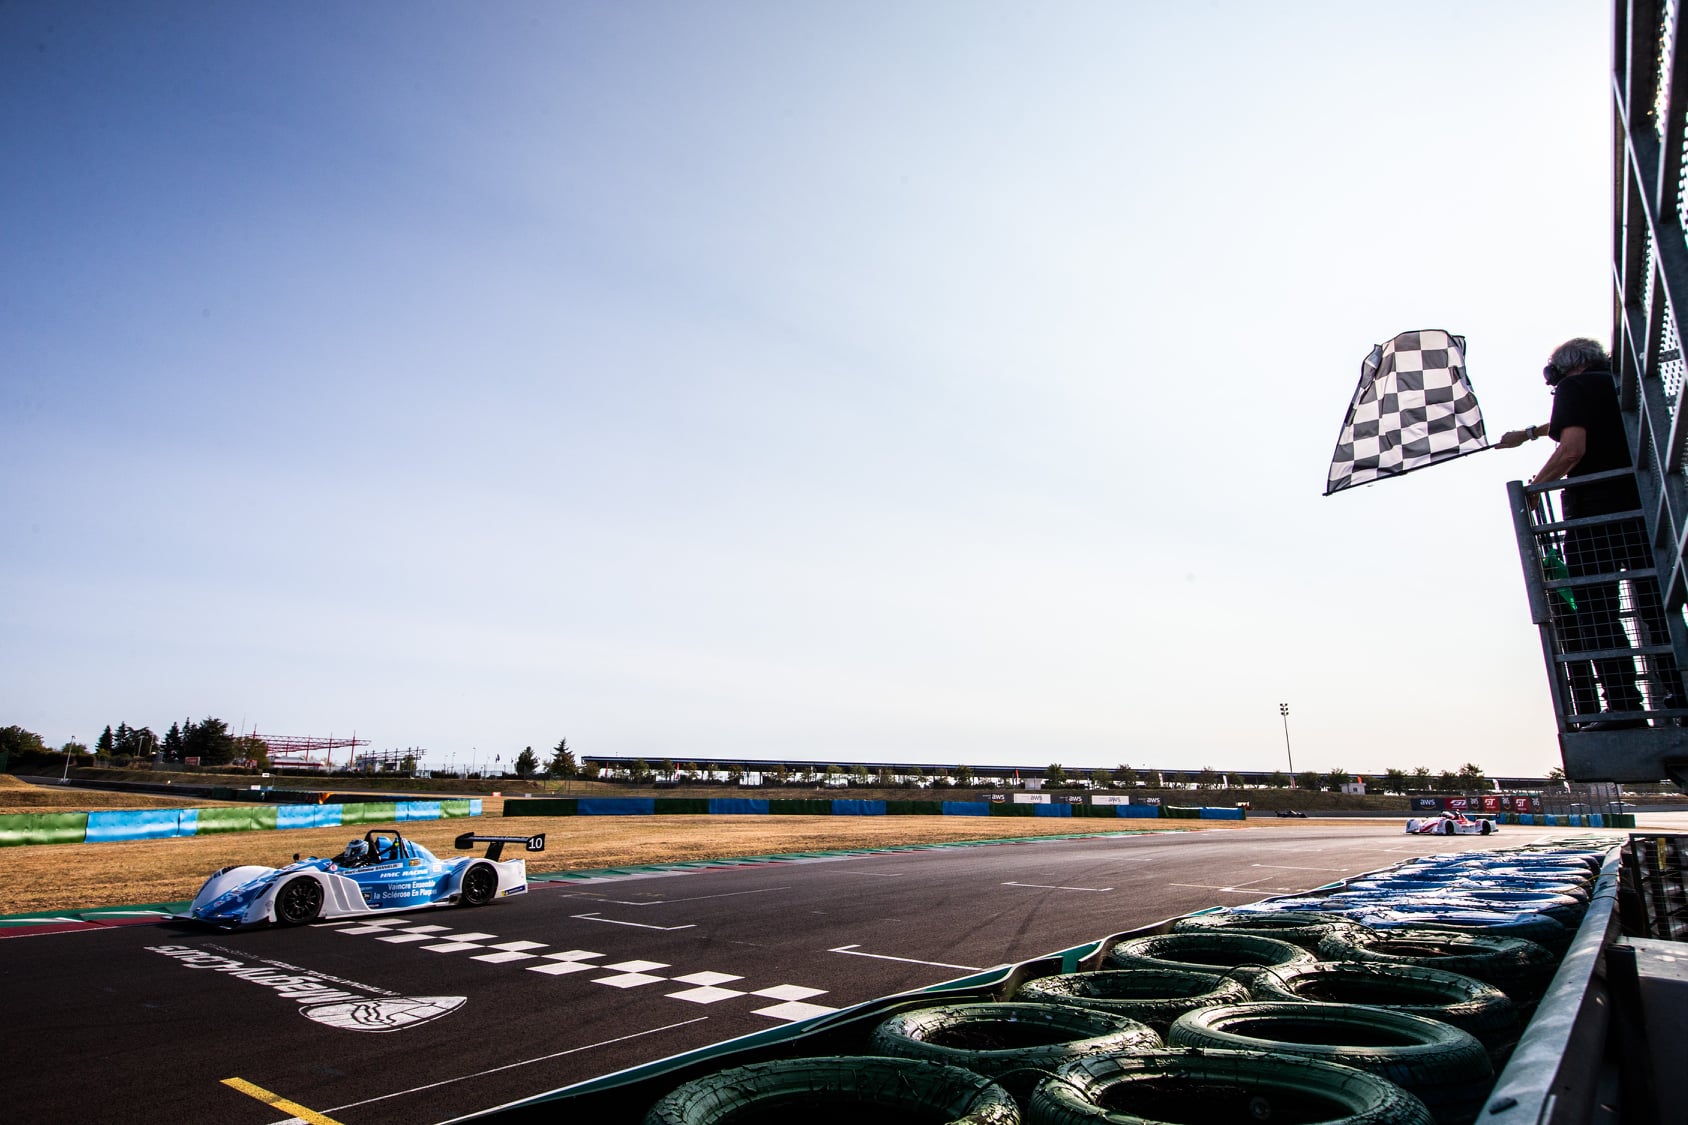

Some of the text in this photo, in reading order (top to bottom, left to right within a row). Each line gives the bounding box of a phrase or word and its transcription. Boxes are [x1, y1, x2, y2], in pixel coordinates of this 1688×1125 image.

[528, 837, 543, 849] 10
[388, 883, 411, 891] Vaincre
[382, 890, 411, 899] Sclérose
[411, 889, 419, 897] En
[143, 944, 366, 1004] Magny-Cours
